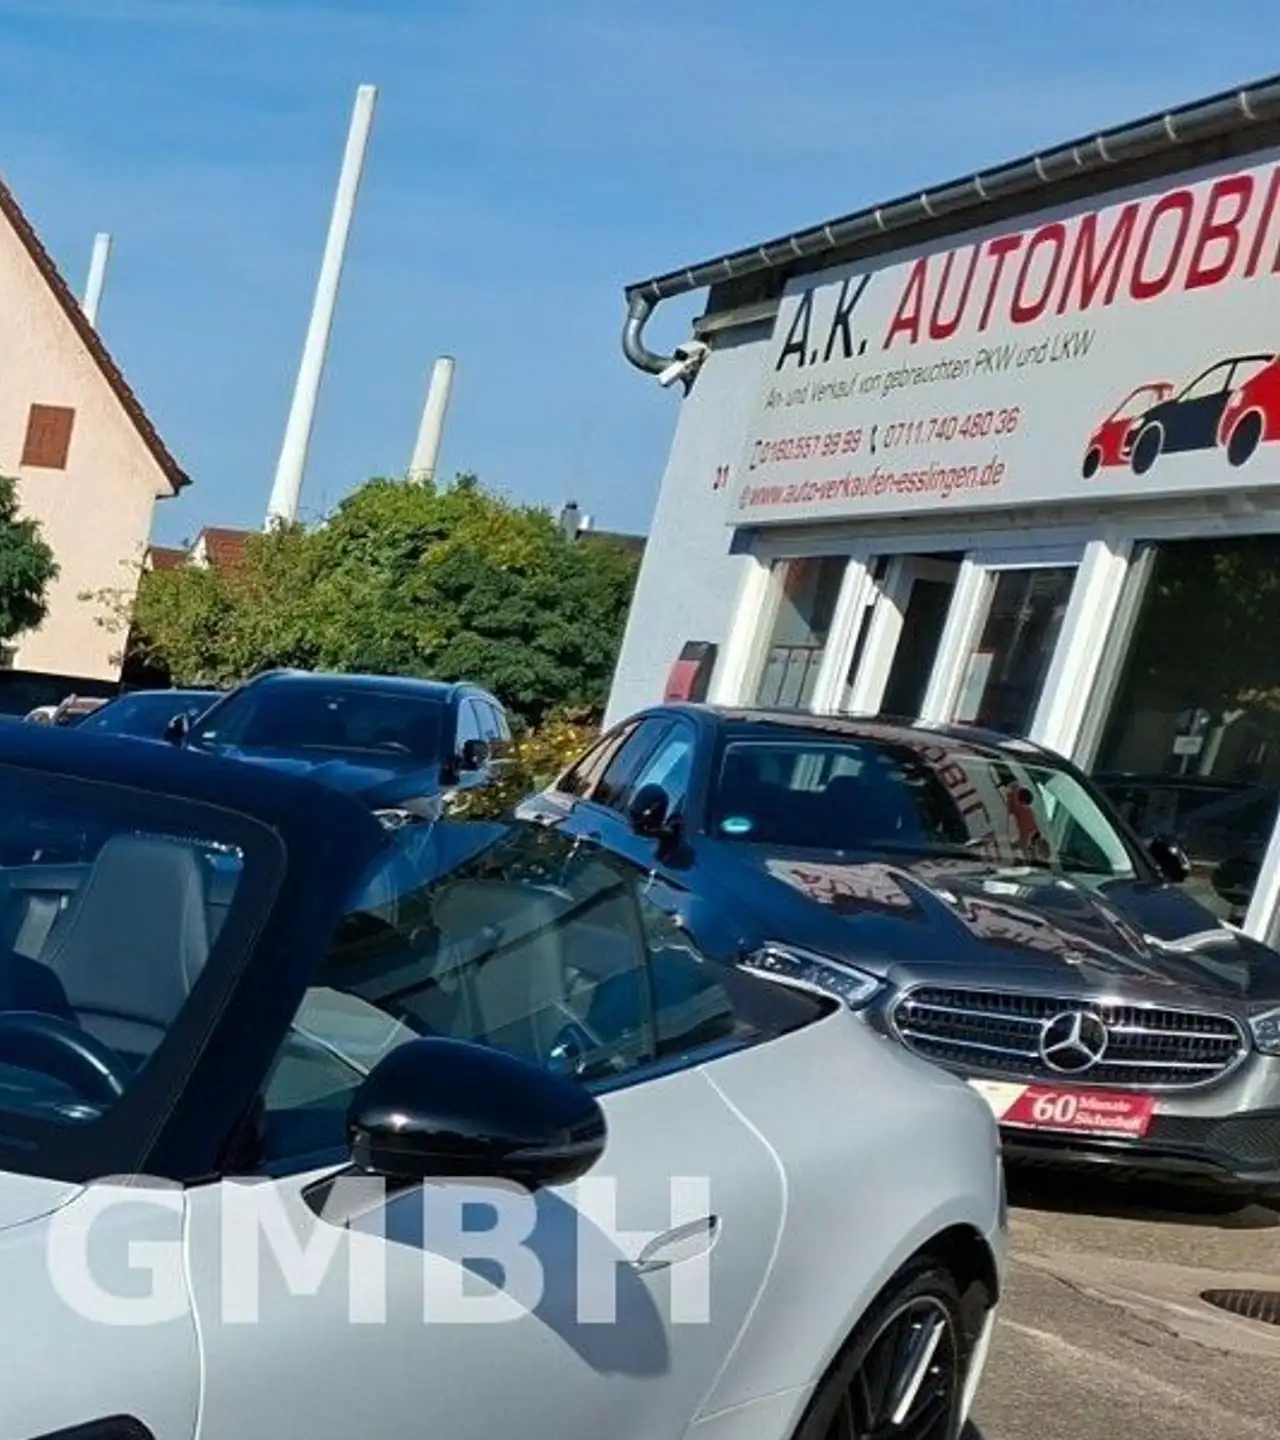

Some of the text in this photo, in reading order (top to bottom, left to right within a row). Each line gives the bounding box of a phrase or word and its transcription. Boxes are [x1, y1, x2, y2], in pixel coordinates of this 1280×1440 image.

[775, 272, 873, 371] A.K.
[881, 358, 973, 398] gebrauchten
[974, 343, 1018, 376] PKW
[1016, 338, 1050, 367] und
[1050, 328, 1097, 361] LKW
[1032, 1094, 1078, 1122] 60
